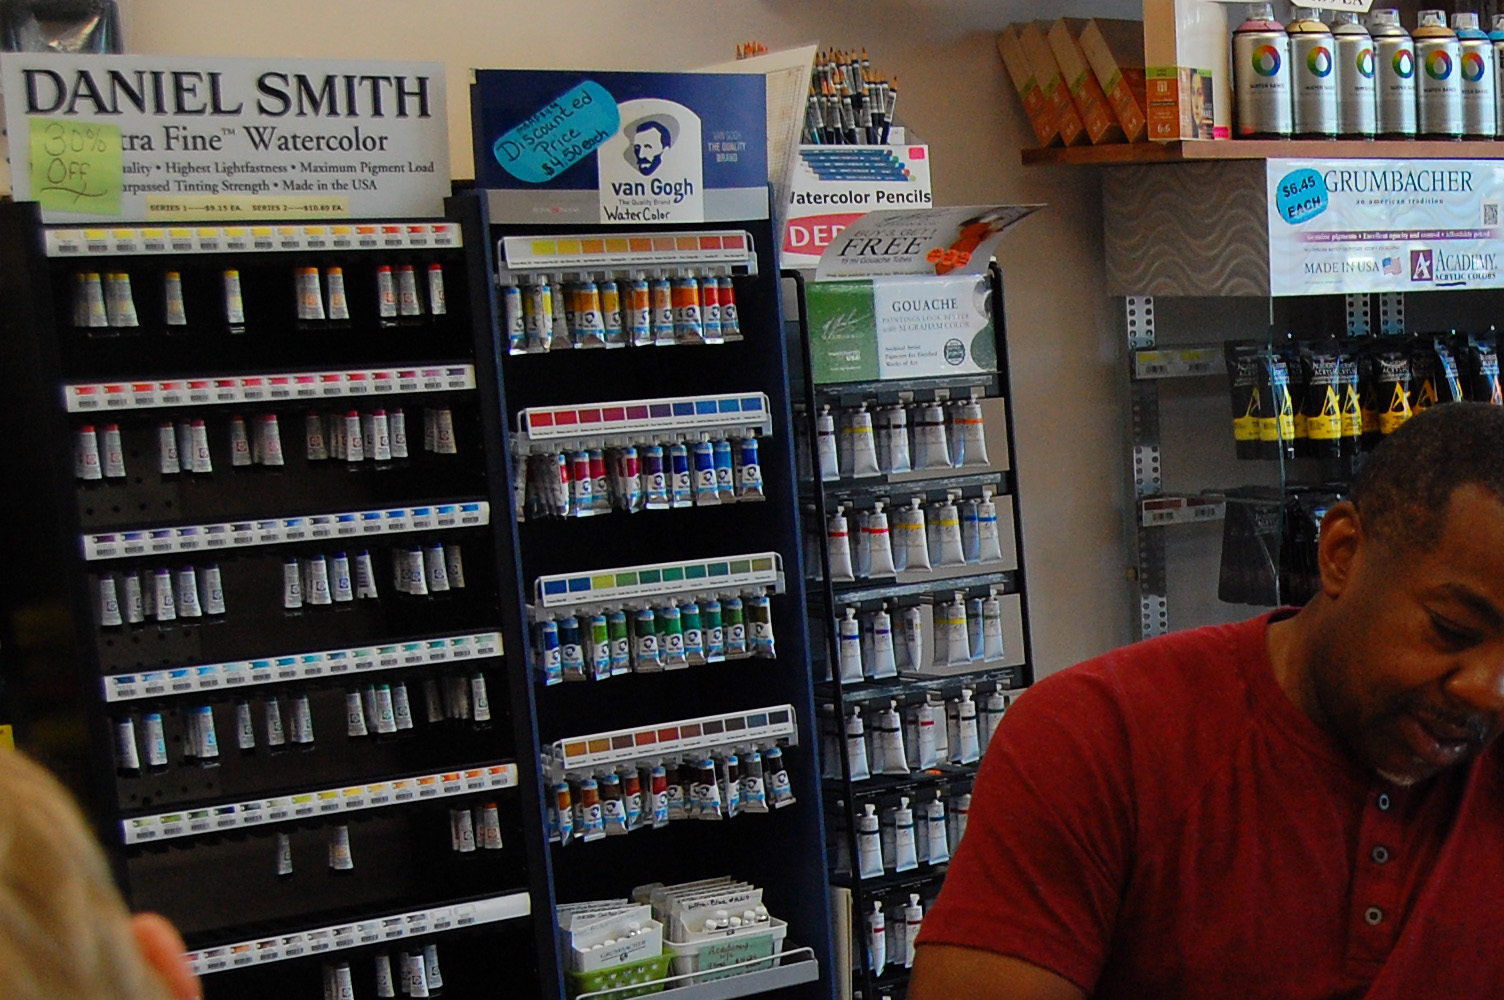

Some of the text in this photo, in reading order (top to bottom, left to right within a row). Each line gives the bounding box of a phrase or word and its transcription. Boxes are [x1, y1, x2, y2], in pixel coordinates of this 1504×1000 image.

[23, 69, 431, 119] DANIEL SMITH
[45, 122, 108, 157] 30%
[243, 126, 390, 153] Watercolor
[533, 128, 582, 157] Price
[166, 162, 434, 181] Highest Lightfastness Maximum Pigment Load
[1324, 169, 1474, 193] GRUMBACHER
[174, 179, 379, 198] Tinting Strength Made in the USA
[612, 178, 693, 204] van Gogh
[876, 189, 931, 204] Pencils
[1282, 175, 1317, 198] $6.45
[1287, 195, 1321, 219] EACH
[838, 236, 932, 257] FREE
[1304, 260, 1380, 275] MADE IN USA
[892, 298, 958, 313] GOUACHE
